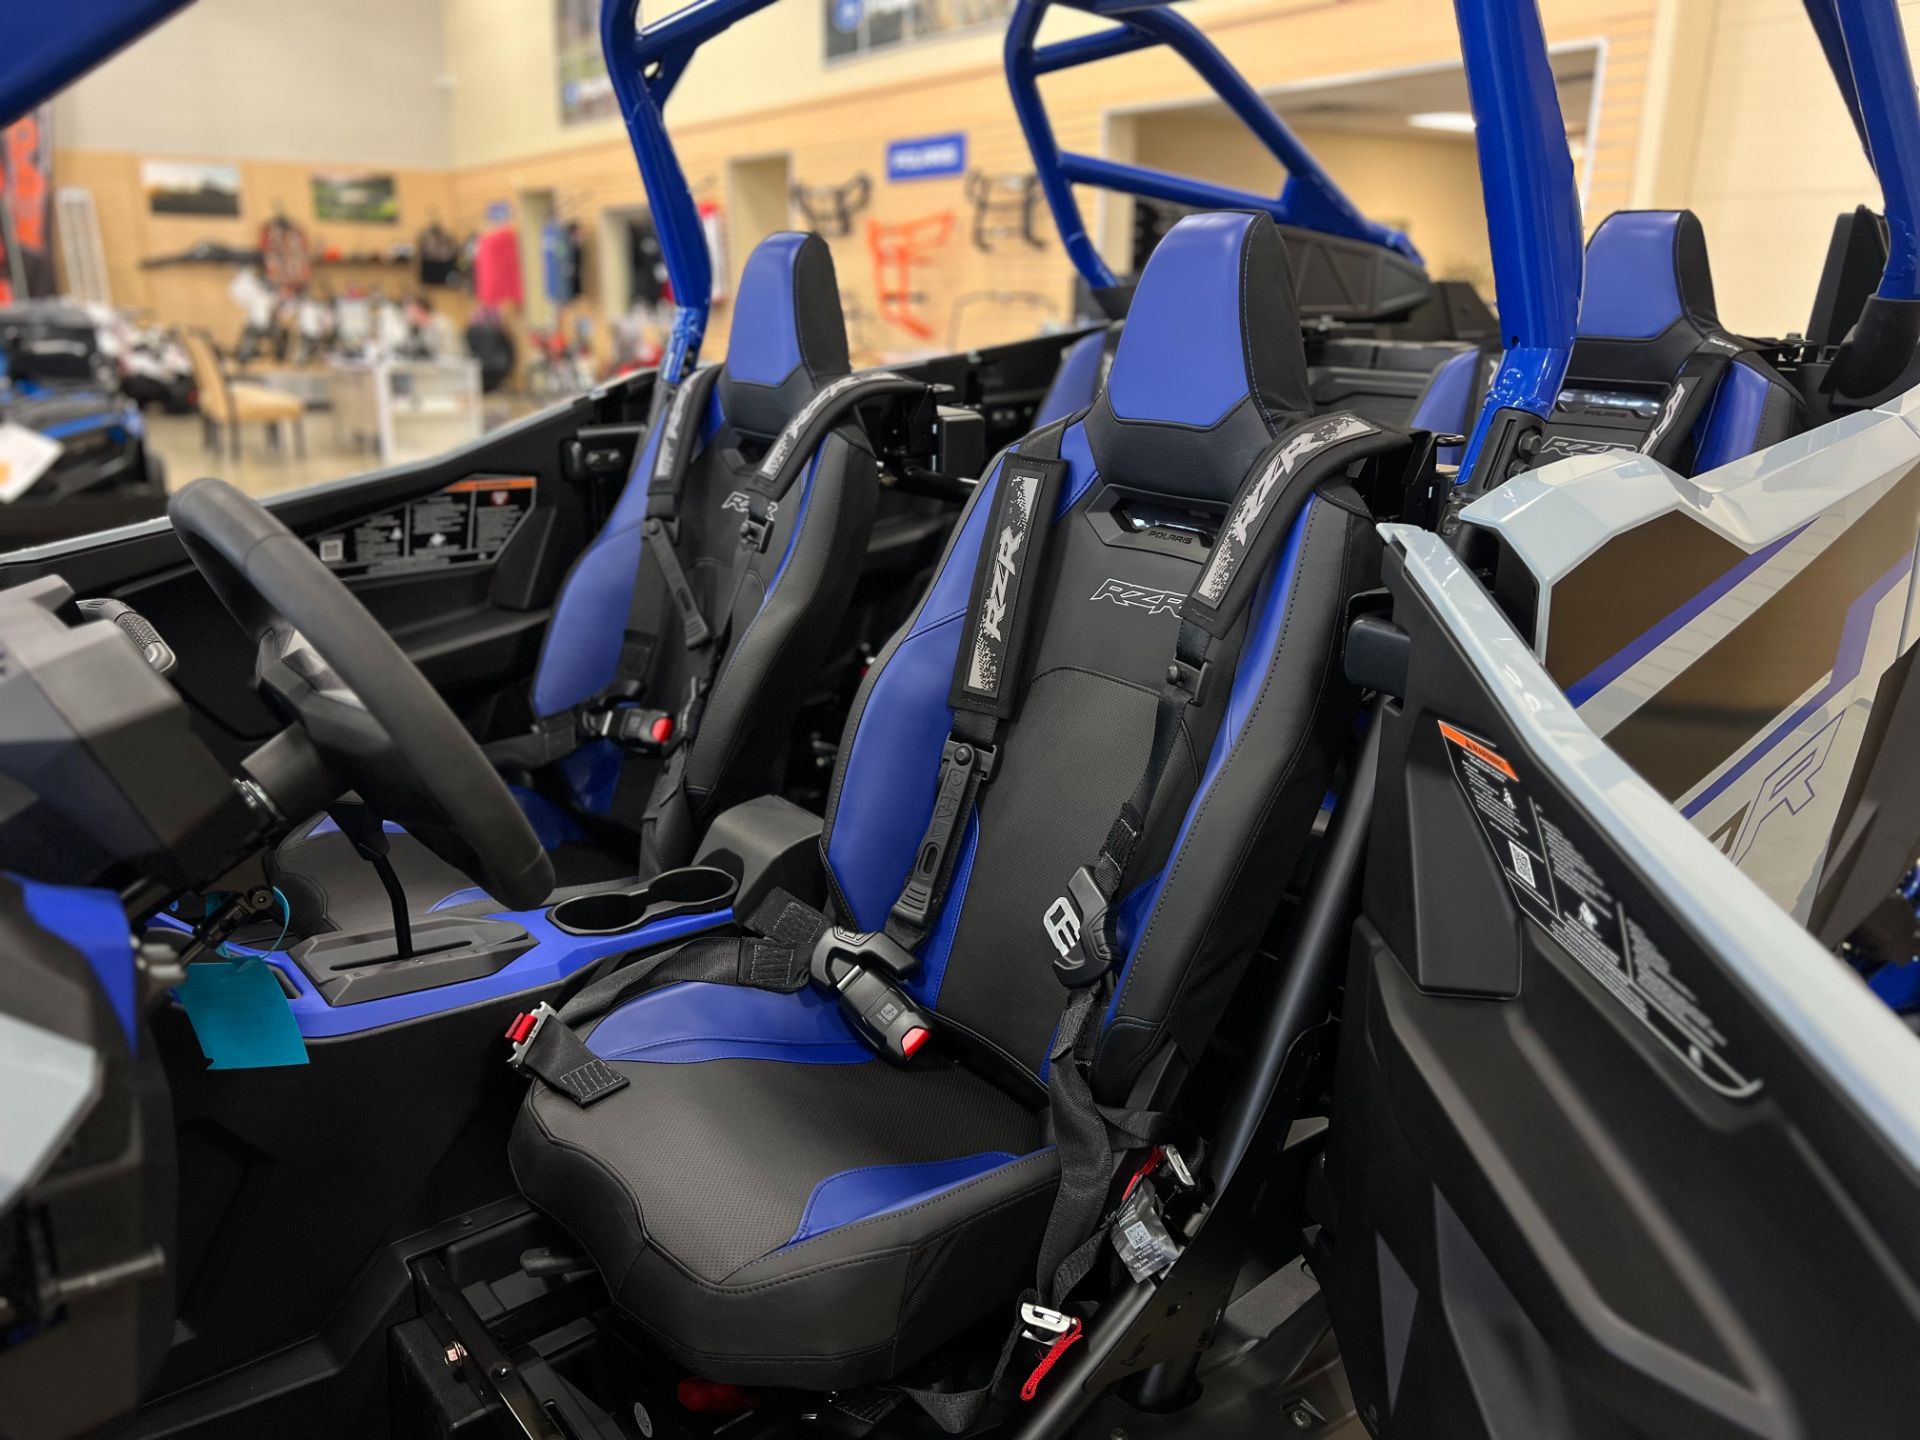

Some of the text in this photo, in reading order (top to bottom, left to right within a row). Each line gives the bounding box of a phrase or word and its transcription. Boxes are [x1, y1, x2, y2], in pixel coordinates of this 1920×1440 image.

[1148, 530, 1193, 545] POLARIS
[1232, 432, 1324, 546] RZR
[984, 525, 1024, 643] RZR
